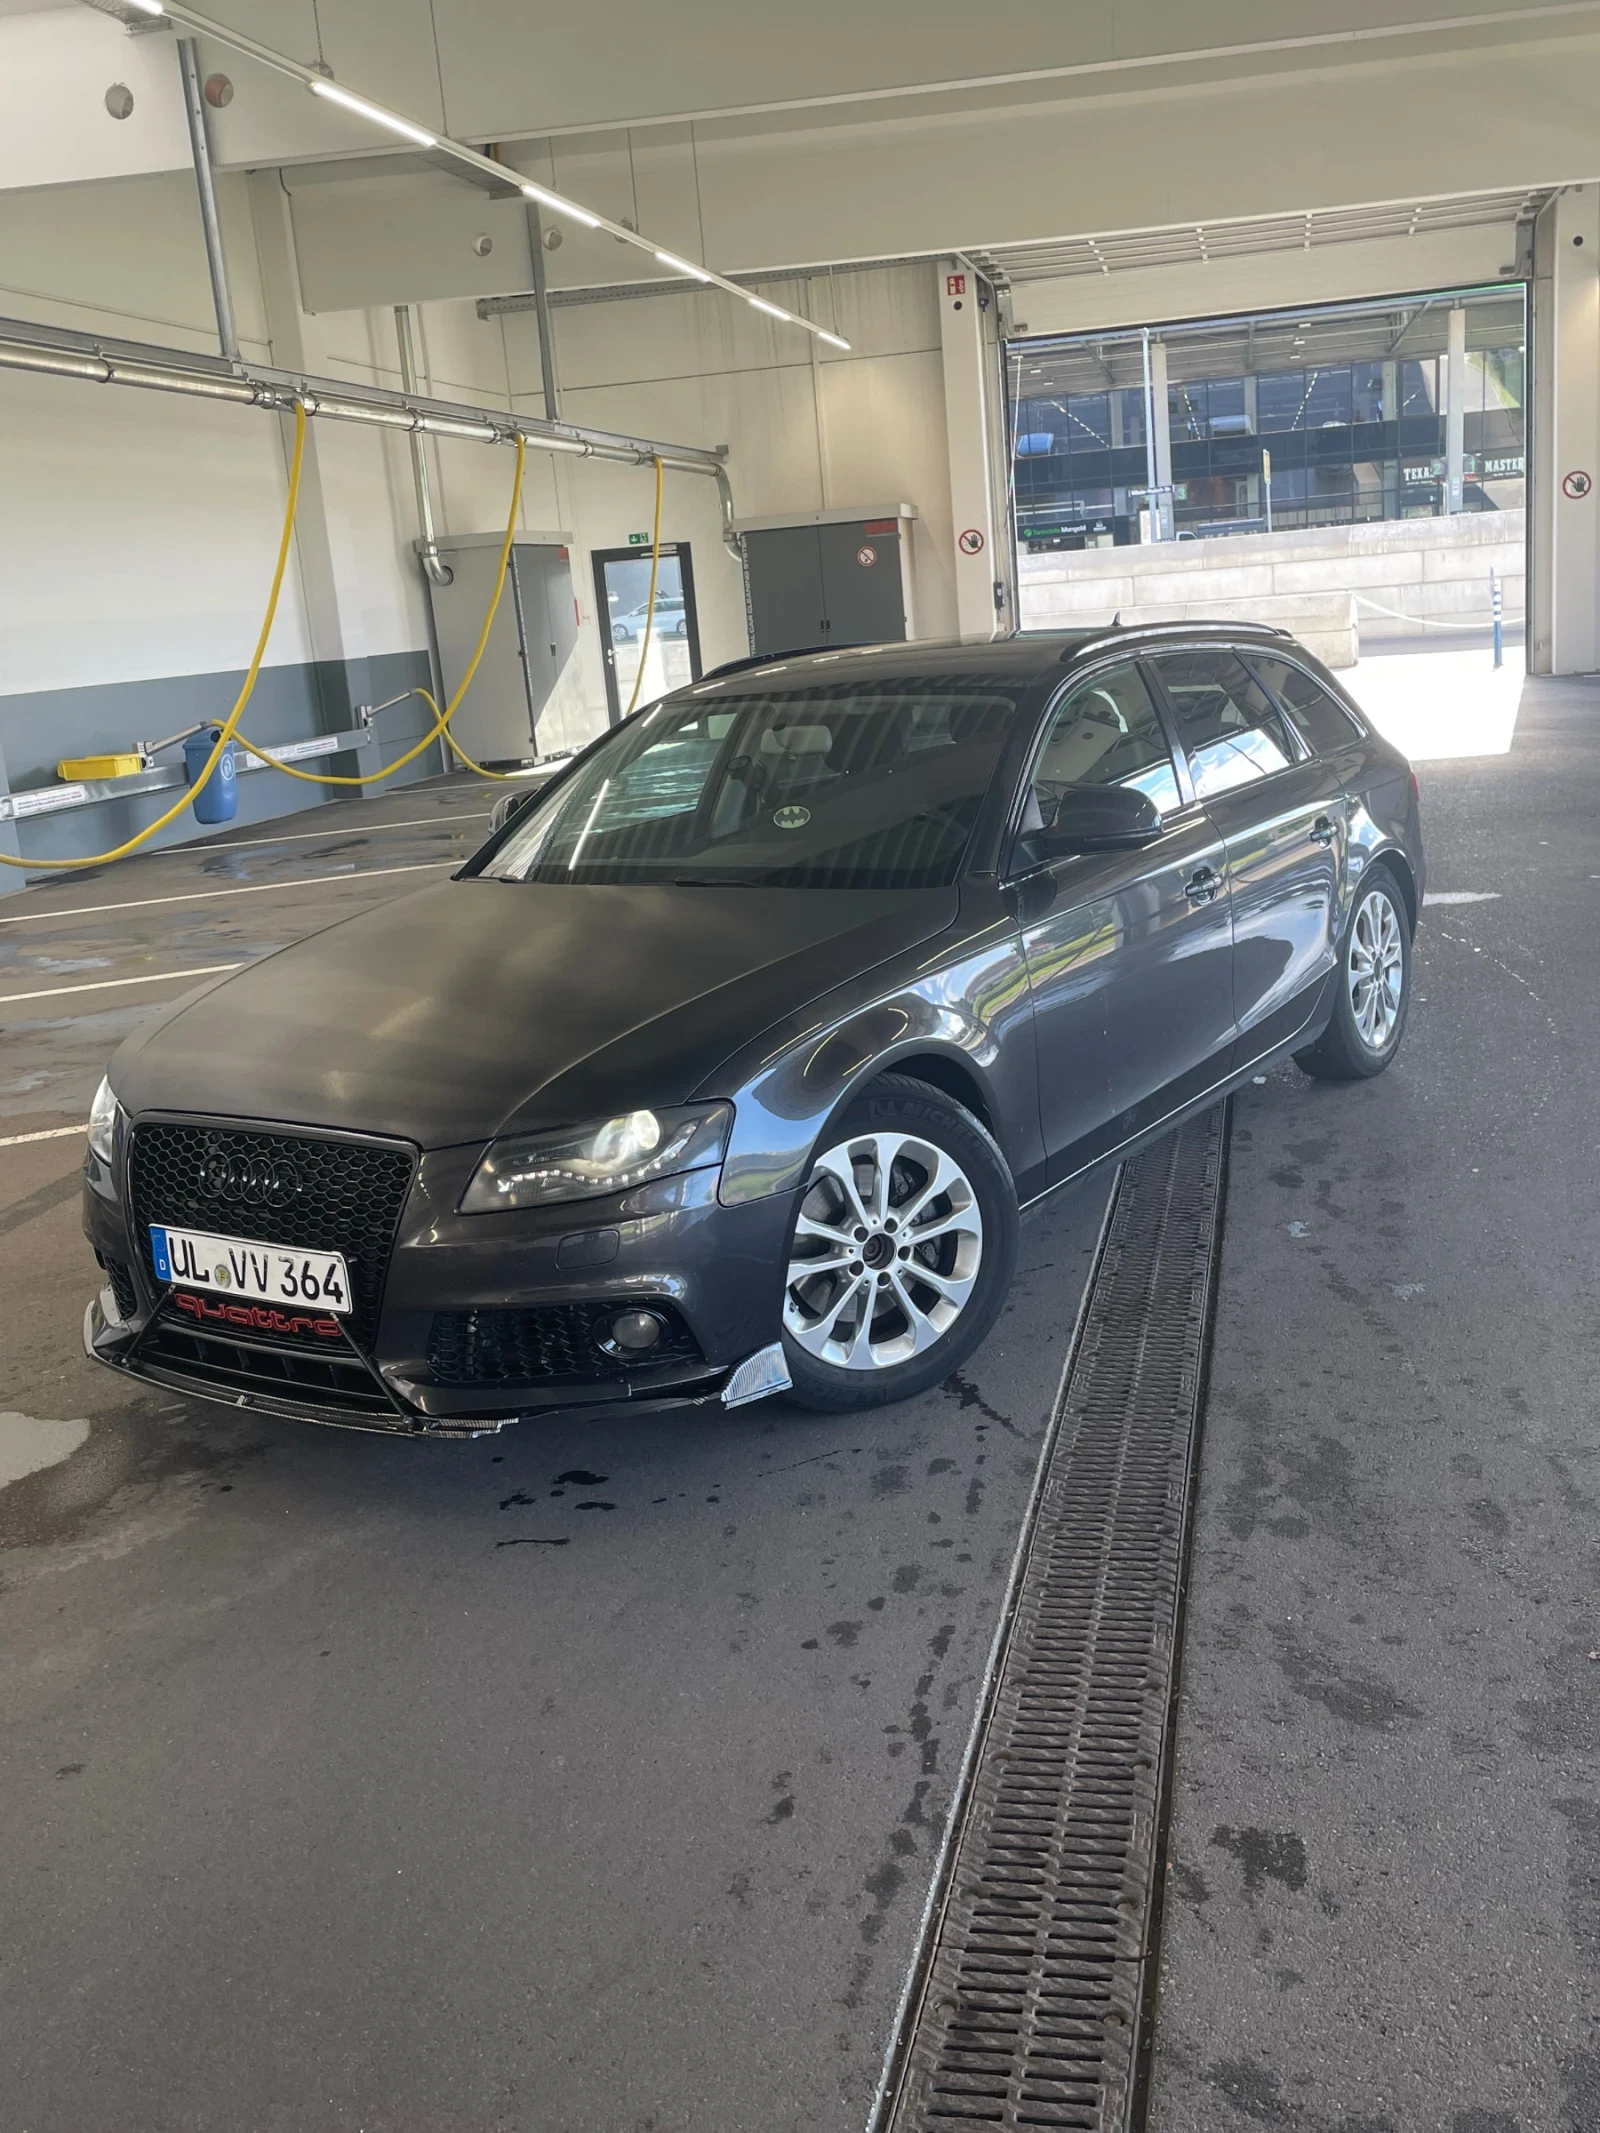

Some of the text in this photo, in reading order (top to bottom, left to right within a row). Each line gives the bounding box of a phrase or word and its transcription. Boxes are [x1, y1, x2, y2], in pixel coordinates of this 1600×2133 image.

[1433, 463, 1441, 475] 2
[1178, 488, 1187, 500] 3
[1061, 524, 1087, 534] Mangold
[741, 535, 749, 570] SYSTEM
[744, 571, 753, 613] CLEANING
[160, 1258, 166, 1271] D
[168, 1237, 344, 1304] UL VV 364
[174, 1293, 343, 1337] quattro
